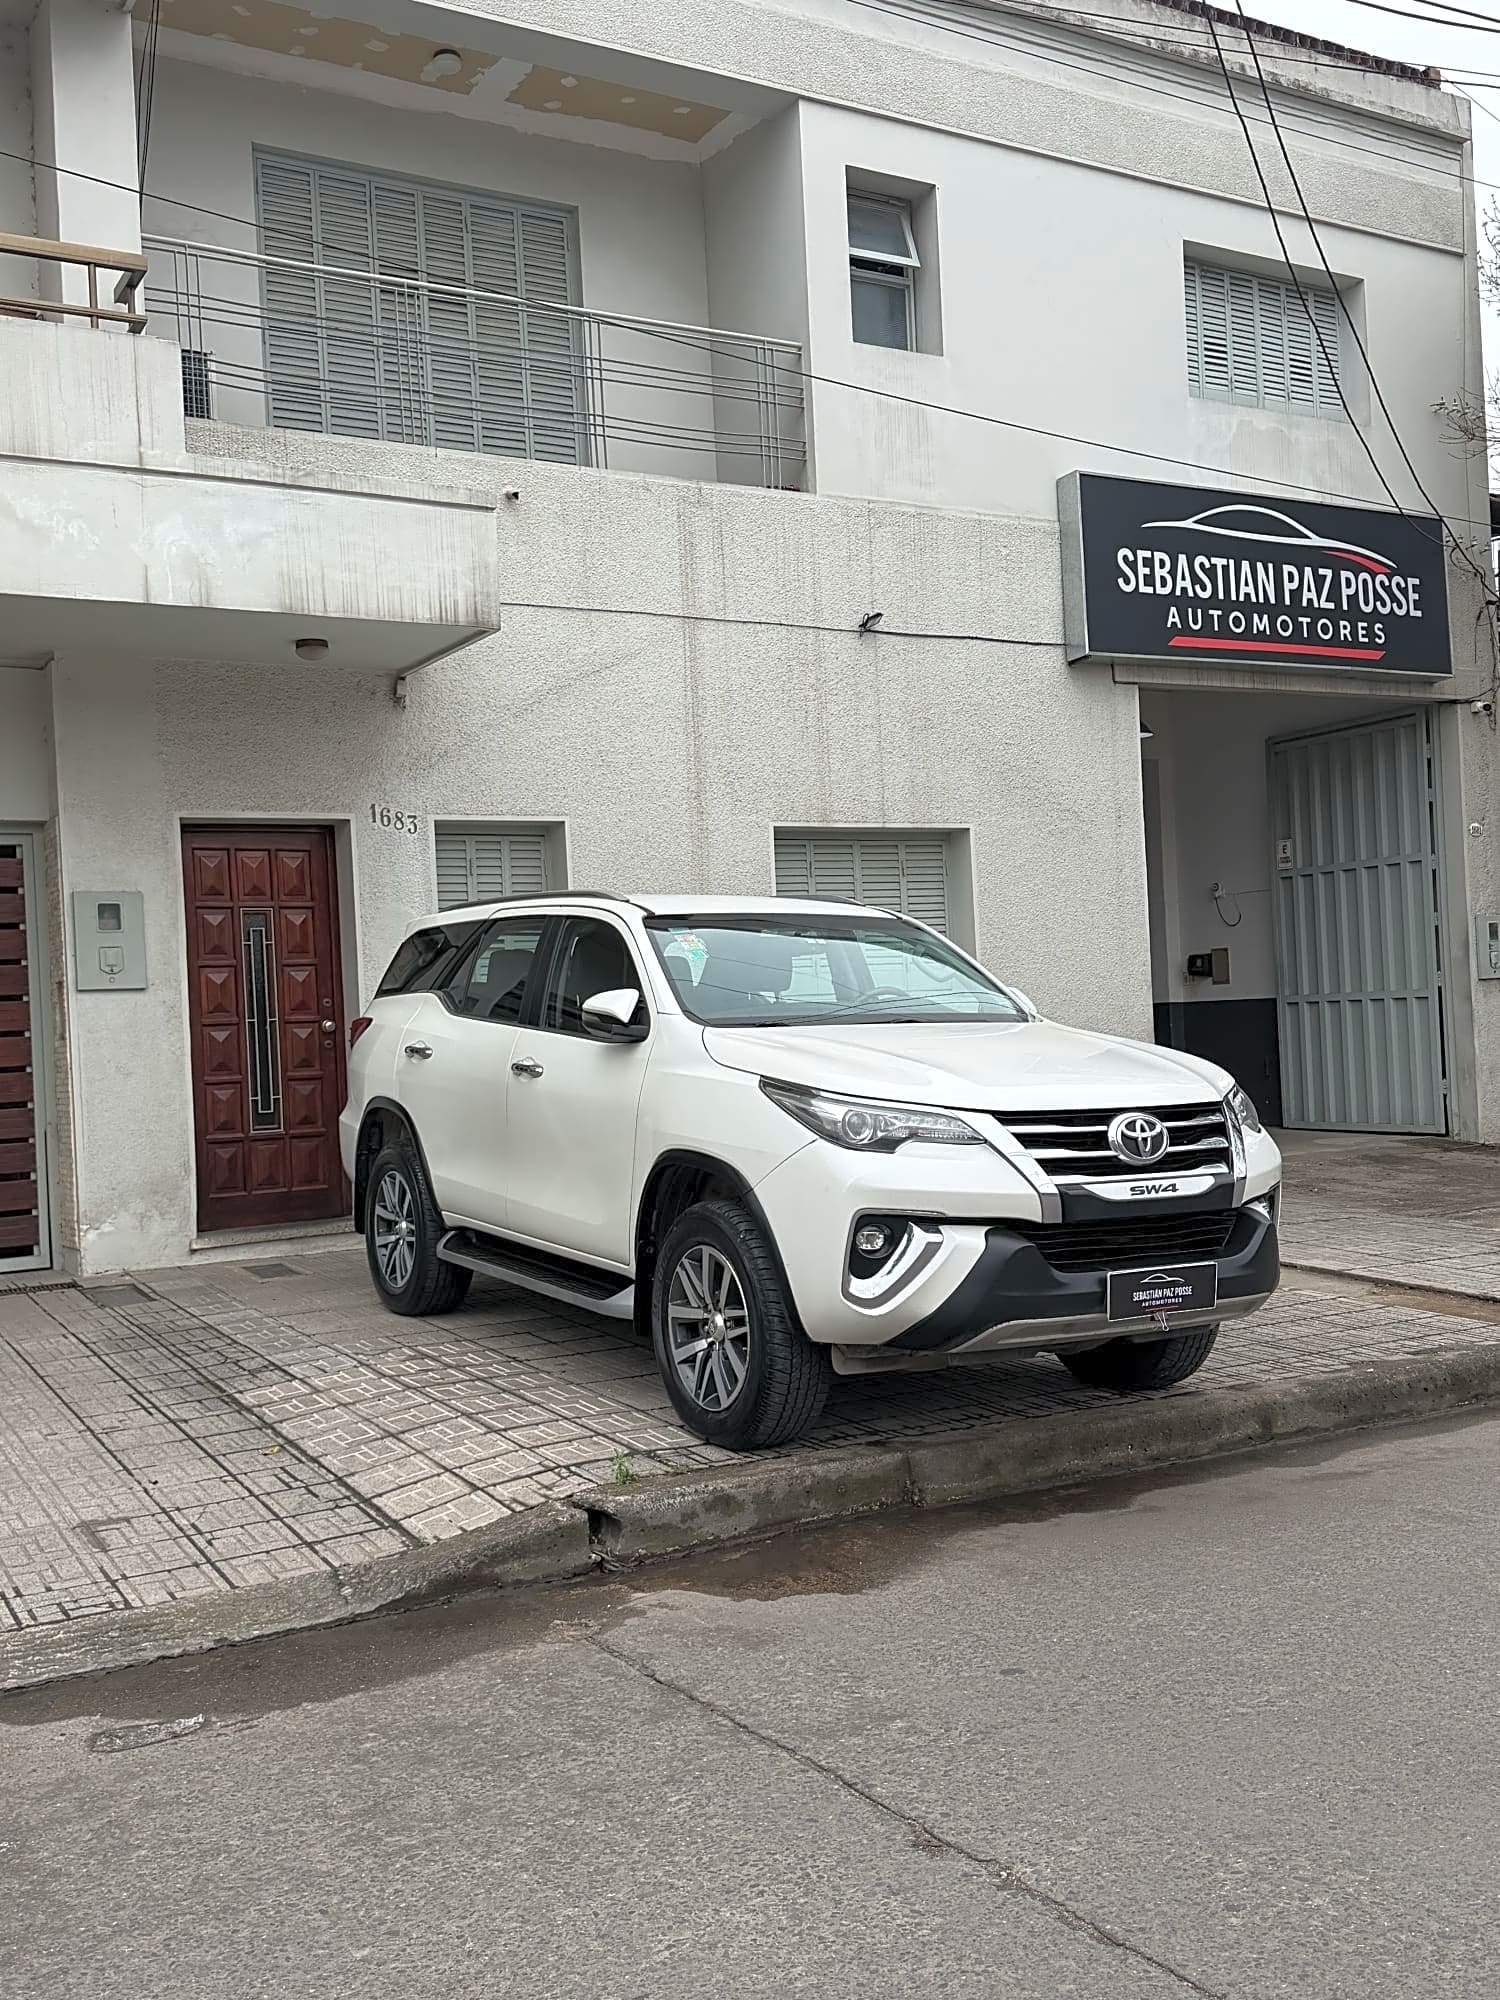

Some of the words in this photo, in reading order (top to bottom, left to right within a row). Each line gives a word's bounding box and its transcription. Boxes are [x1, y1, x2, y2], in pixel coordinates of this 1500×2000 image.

[1117, 547, 1276, 604] SEBASTIAN
[1283, 563, 1335, 609] PAZ
[1341, 571, 1423, 617] POSSE
[1167, 606, 1386, 644] AUTOMOTORES
[369, 803, 418, 834] 1683
[1129, 1183, 1179, 1196] SW4
[1163, 1287, 1174, 1297] PAZ
[1175, 1286, 1192, 1296] POSSE
